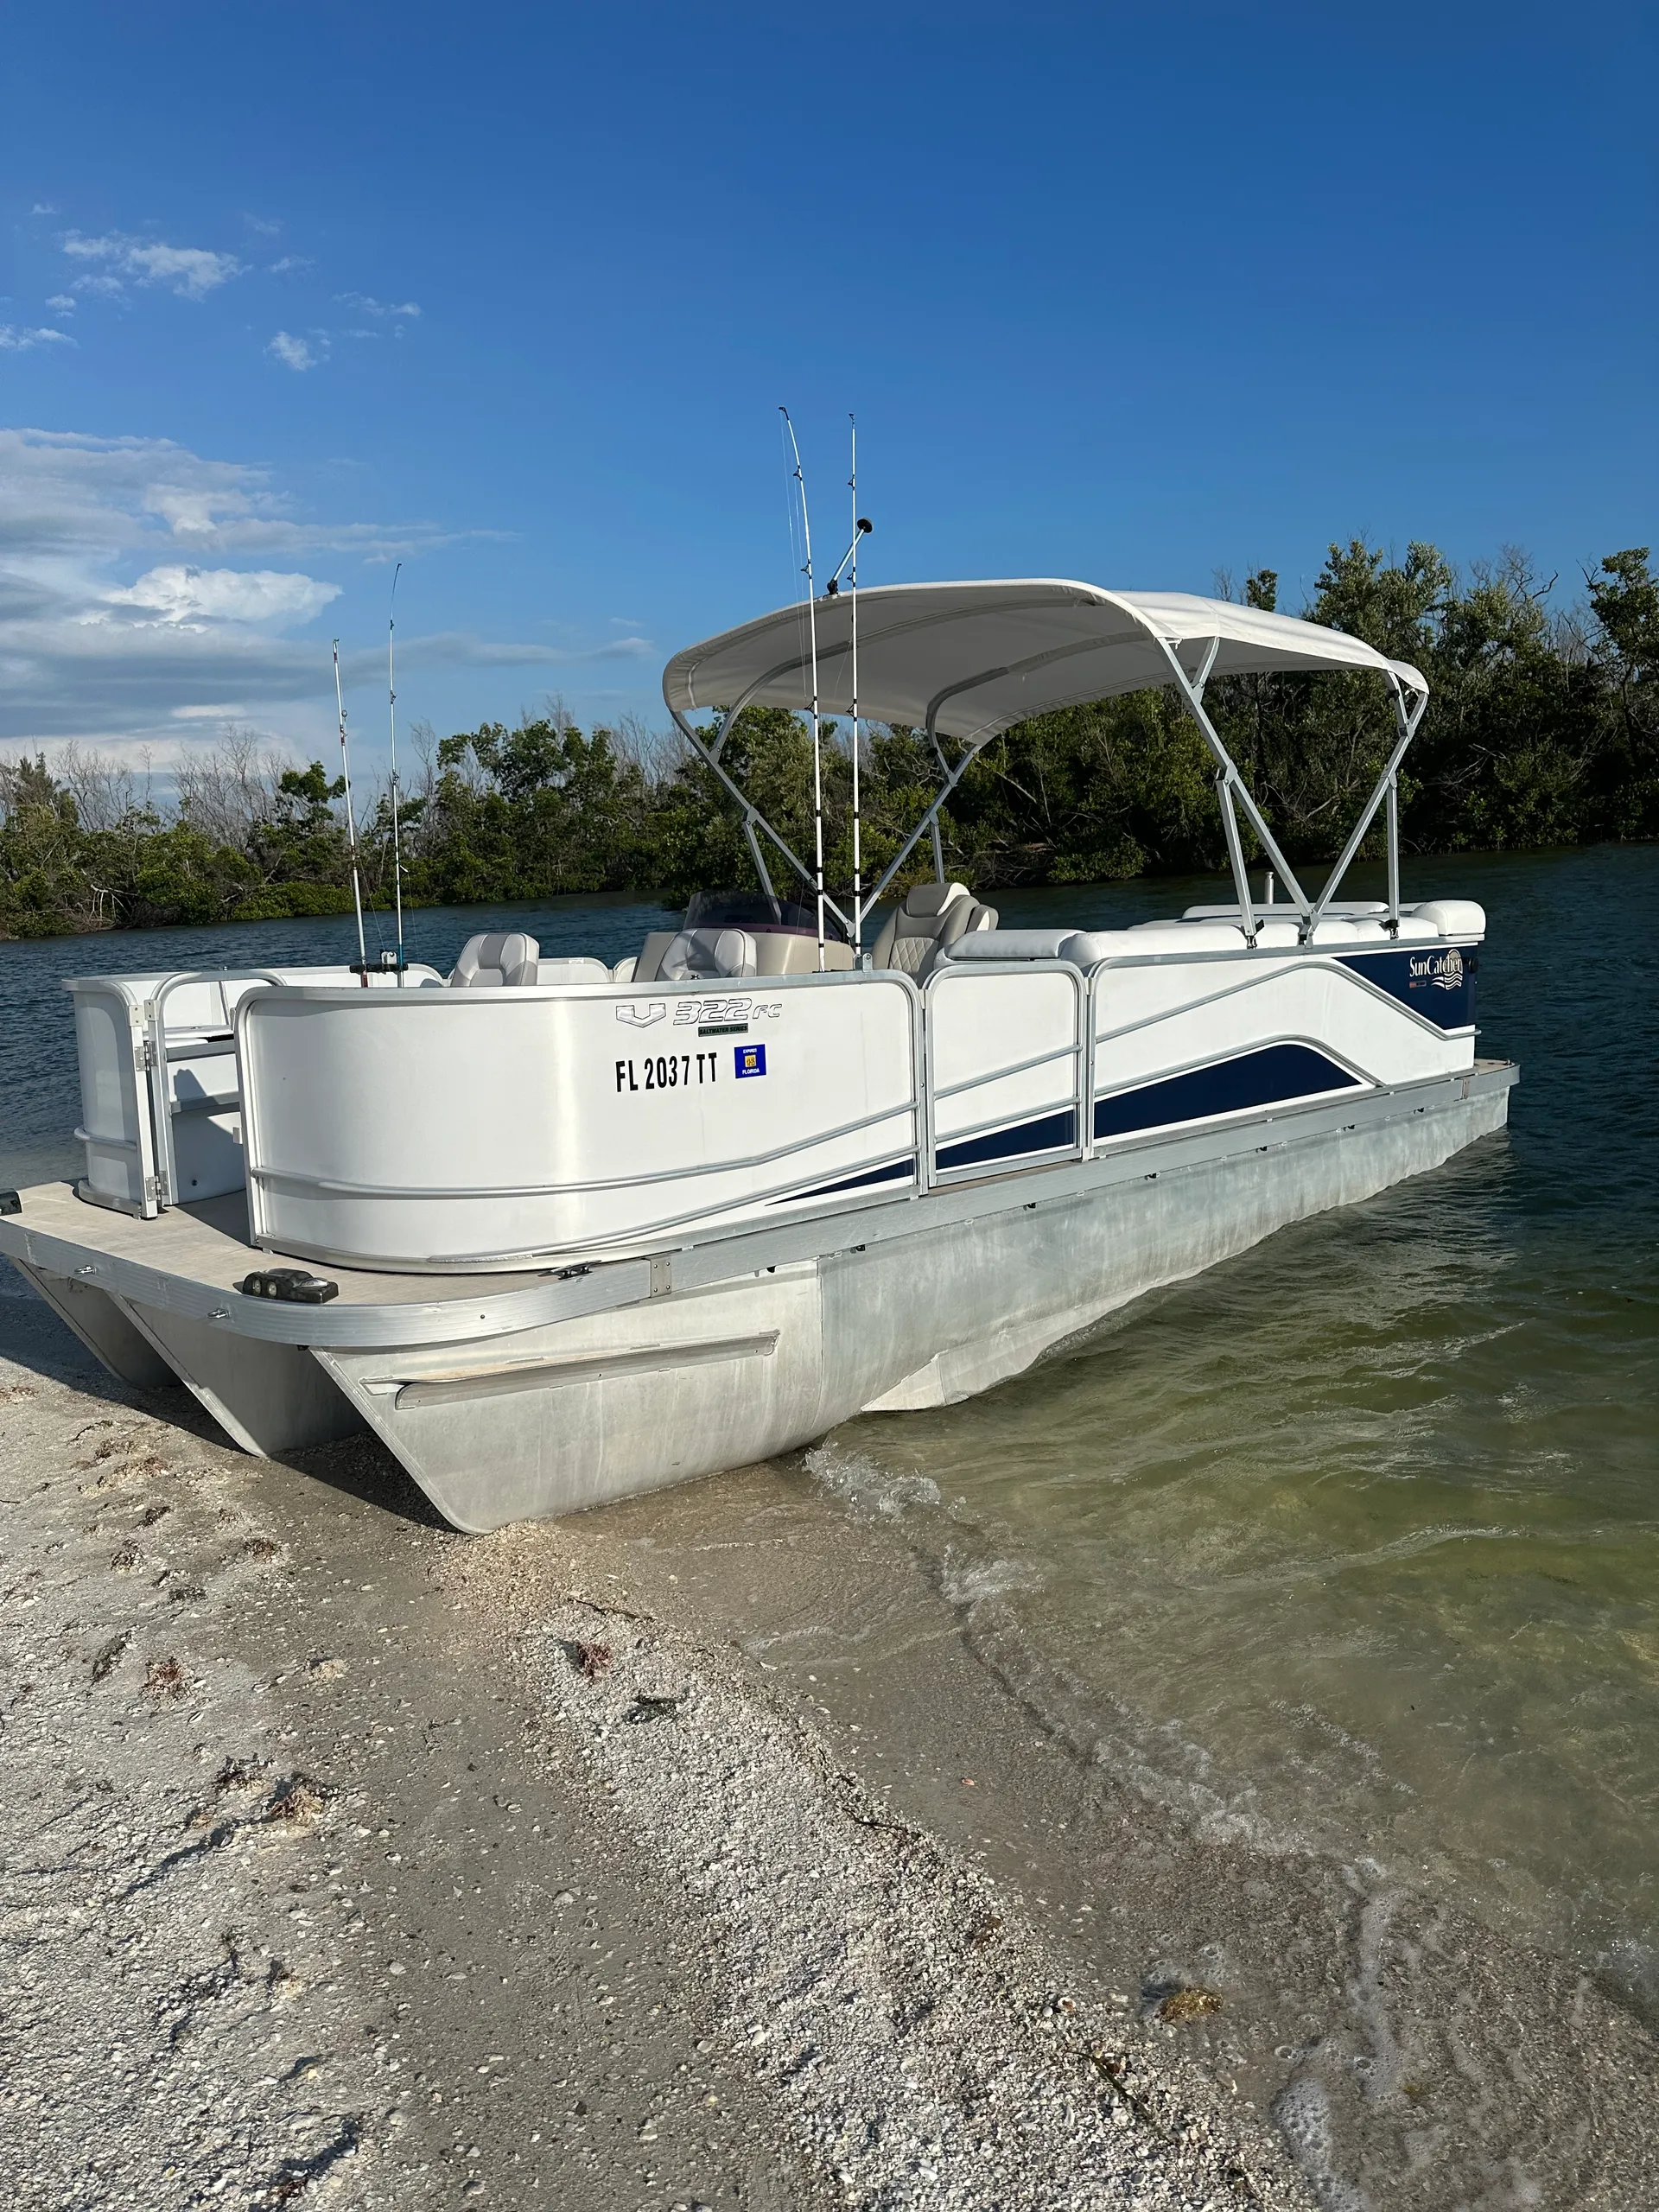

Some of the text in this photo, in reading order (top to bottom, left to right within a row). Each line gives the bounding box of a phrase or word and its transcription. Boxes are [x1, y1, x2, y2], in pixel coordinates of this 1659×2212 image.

[1409, 954, 1463, 977] SunCatcher
[673, 998, 752, 1026] 322
[753, 1004, 782, 1019] FC
[616, 1052, 717, 1092] FL 2037 TT
